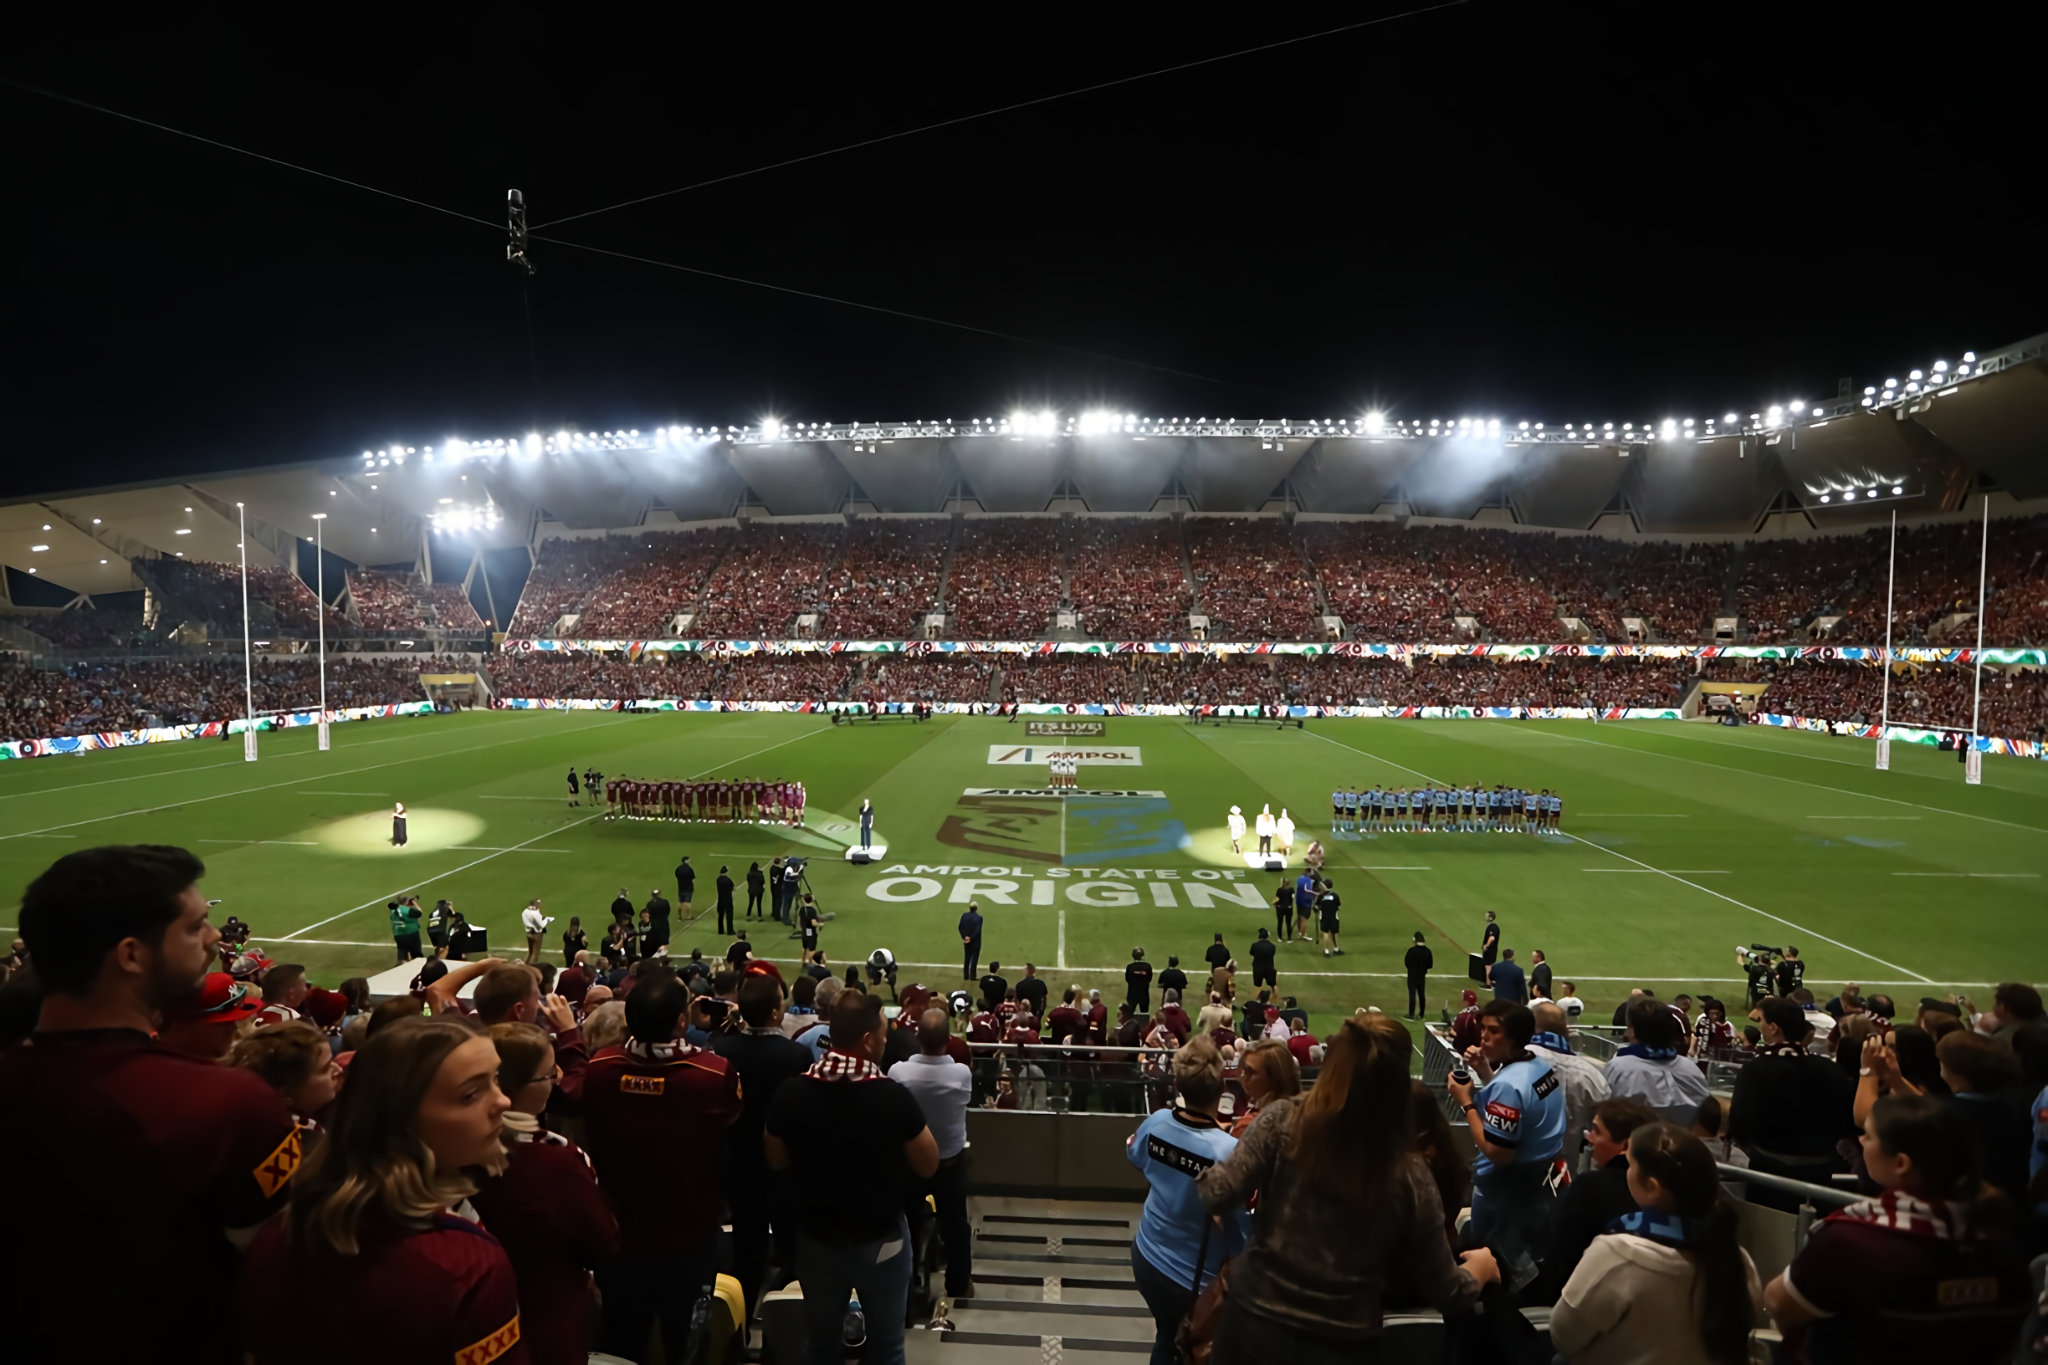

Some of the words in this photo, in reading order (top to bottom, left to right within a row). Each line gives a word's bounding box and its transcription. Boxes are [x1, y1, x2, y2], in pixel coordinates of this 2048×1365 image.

[1061, 722, 1102, 730] LIVE!
[979, 789, 1153, 797] AMPOL
[880, 864, 1034, 877] AMPOL
[1046, 867, 1182, 880] STATE
[1191, 869, 1247, 880] OF
[865, 877, 1270, 909] ORIGIN
[461, 1321, 519, 1365] XXXX
